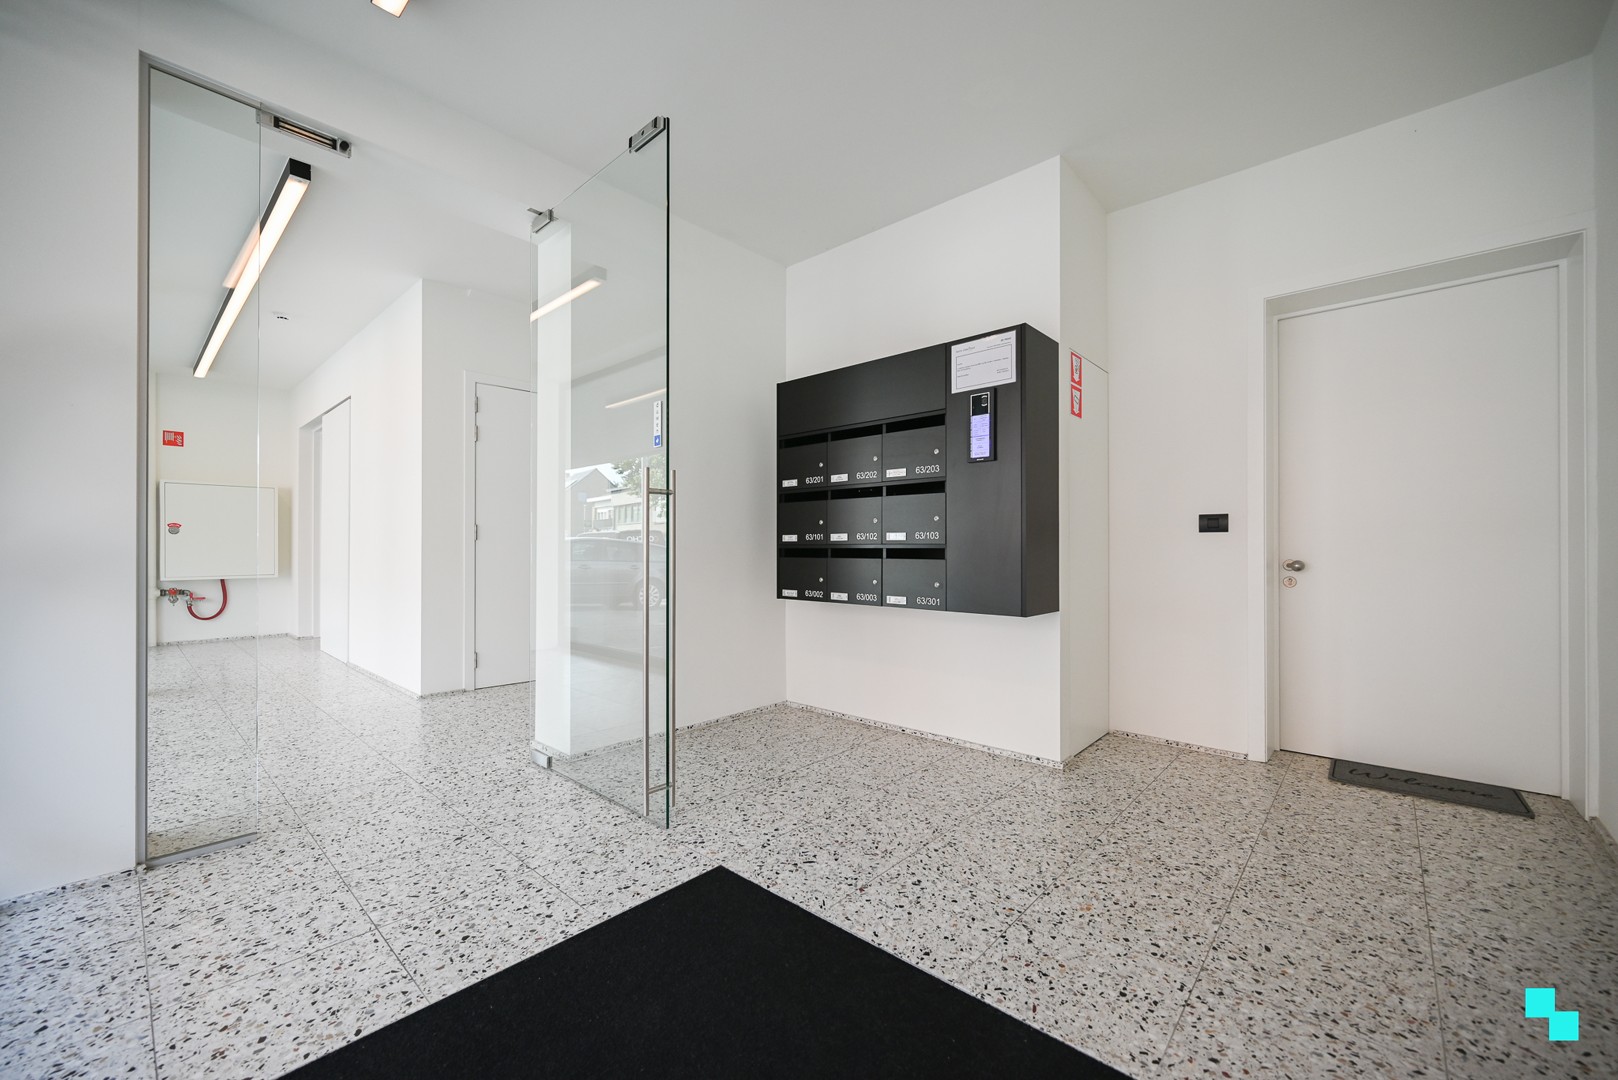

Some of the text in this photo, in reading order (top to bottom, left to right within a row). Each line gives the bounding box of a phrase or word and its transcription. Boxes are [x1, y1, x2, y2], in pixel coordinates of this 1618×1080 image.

[915, 464, 940, 474] 63/203
[805, 475, 824, 485] 63/201
[856, 471, 878, 480] 63/202
[805, 533, 824, 541] 63/101
[856, 532, 878, 541] 63/102
[914, 531, 940, 540] 63/103
[804, 589, 824, 598] 63/002
[856, 592, 878, 602] 63/003
[916, 596, 940, 606] 63/301
